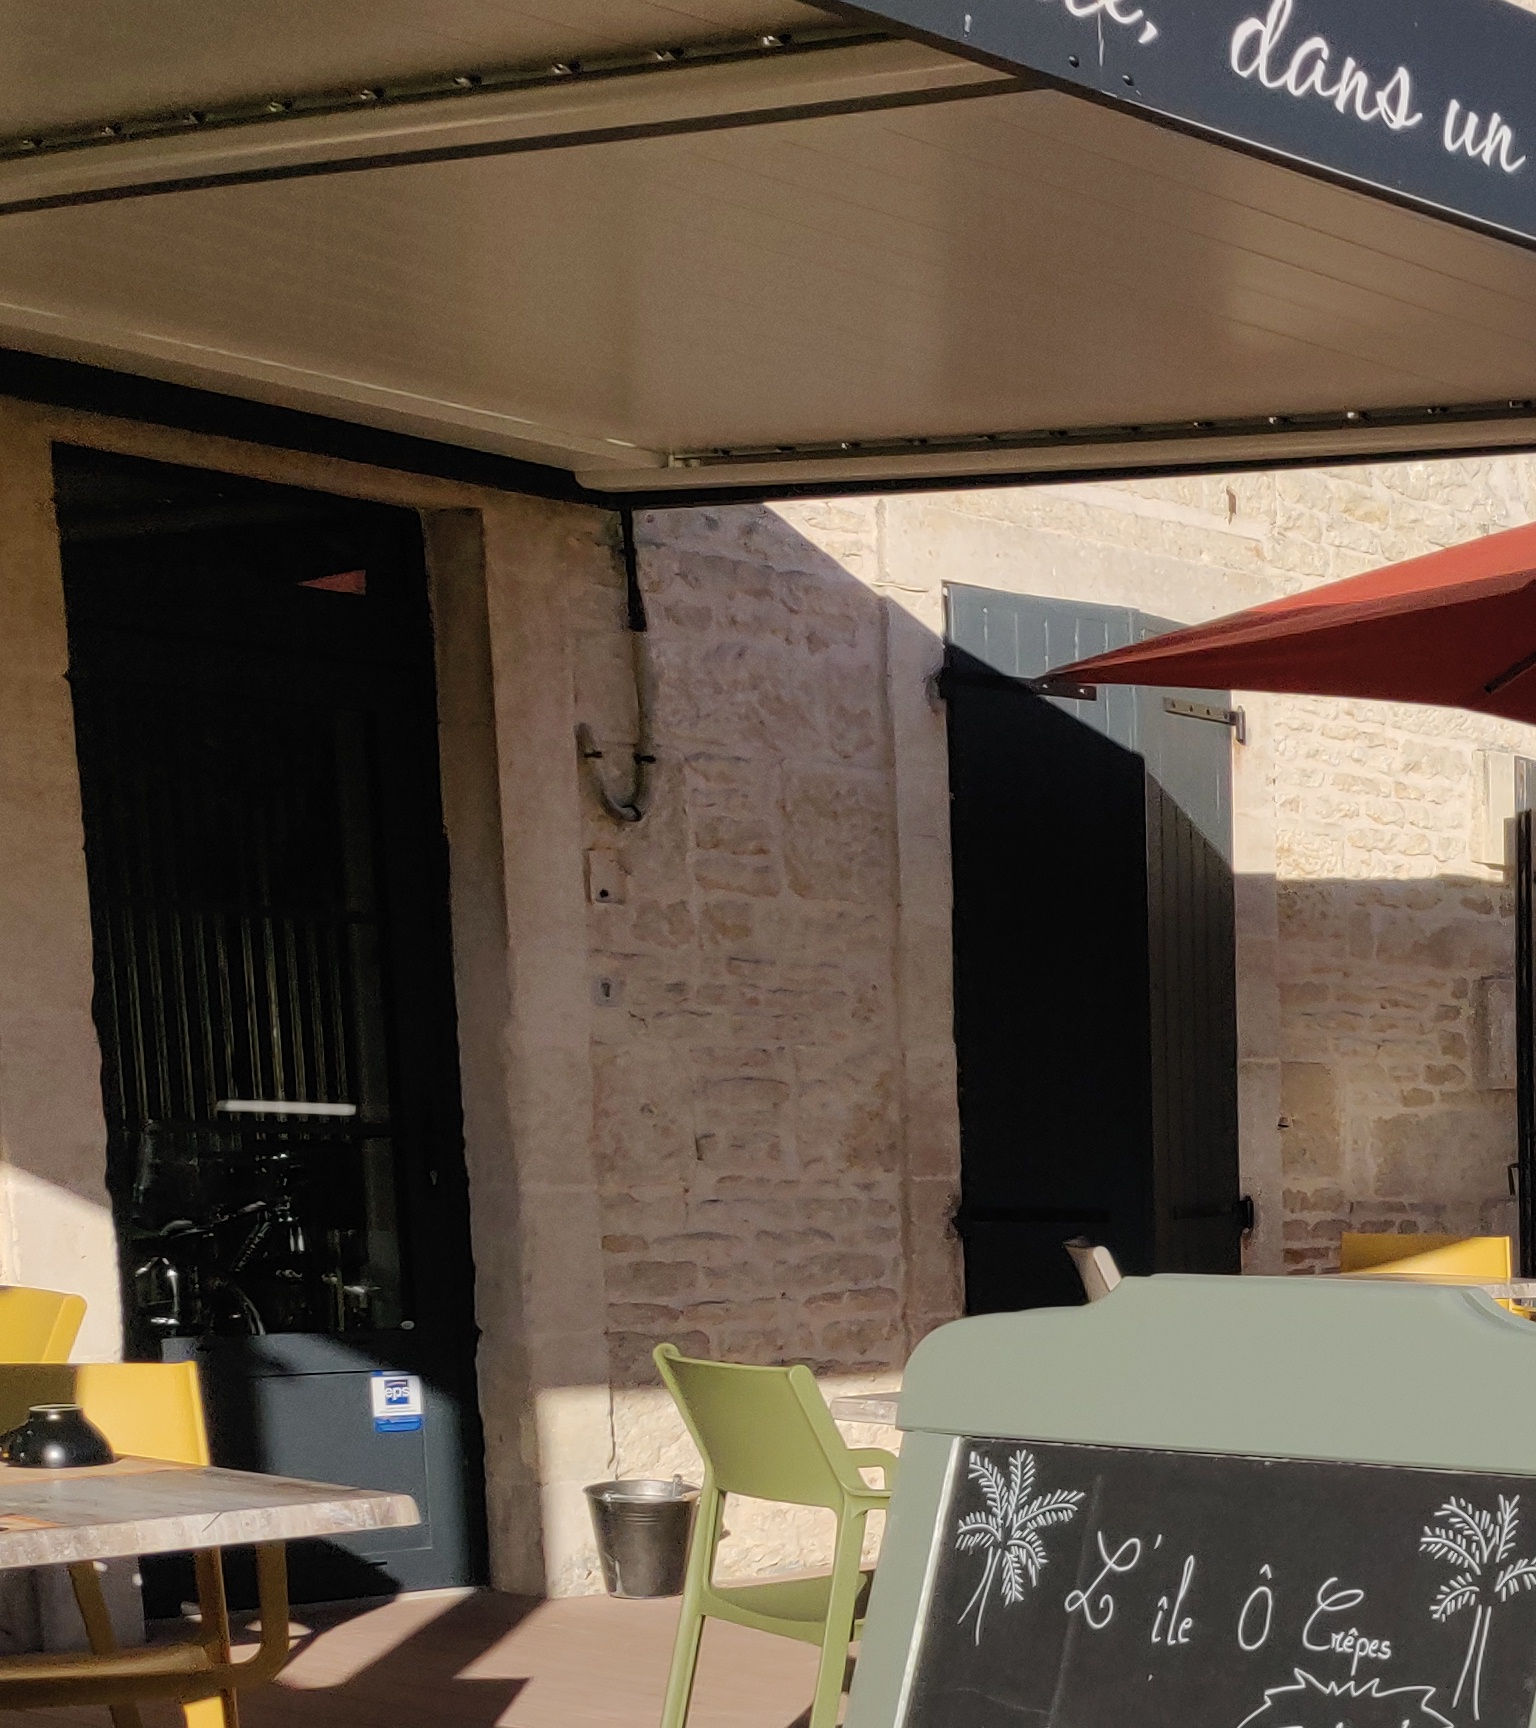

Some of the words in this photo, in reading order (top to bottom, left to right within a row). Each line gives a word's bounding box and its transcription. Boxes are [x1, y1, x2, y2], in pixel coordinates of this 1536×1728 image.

[1230, 0, 1423, 130] dans
[1443, 98, 1526, 173] un
[1302, 1576, 1392, 1676] Crêpes
